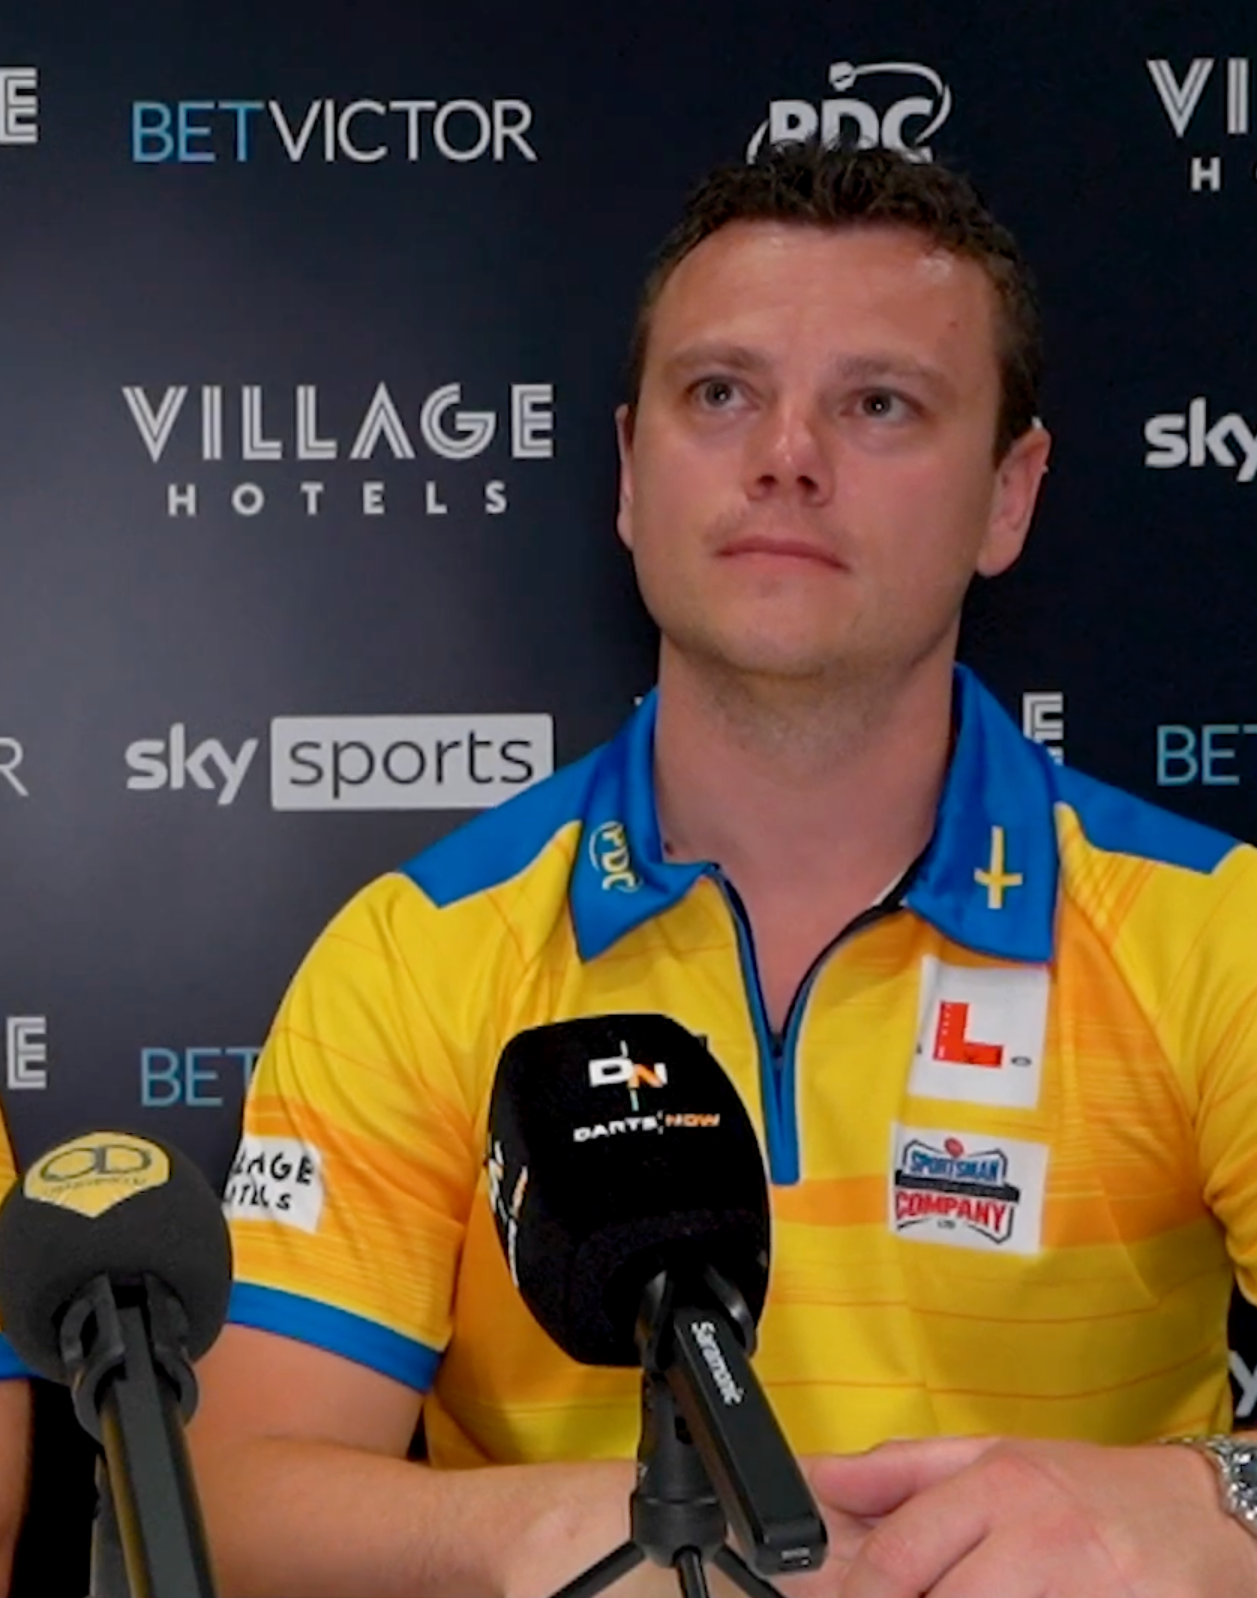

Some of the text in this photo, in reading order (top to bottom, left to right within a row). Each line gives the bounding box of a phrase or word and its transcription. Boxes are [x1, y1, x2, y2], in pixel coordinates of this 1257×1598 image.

[132, 100, 537, 163] BETVICTOR
[122, 381, 554, 463] VILLAGE
[167, 481, 508, 517] HOTELS
[124, 722, 534, 806] sky sports
[1156, 725, 1257, 786] BE
[895, 1190, 1007, 1233] COMPANY
